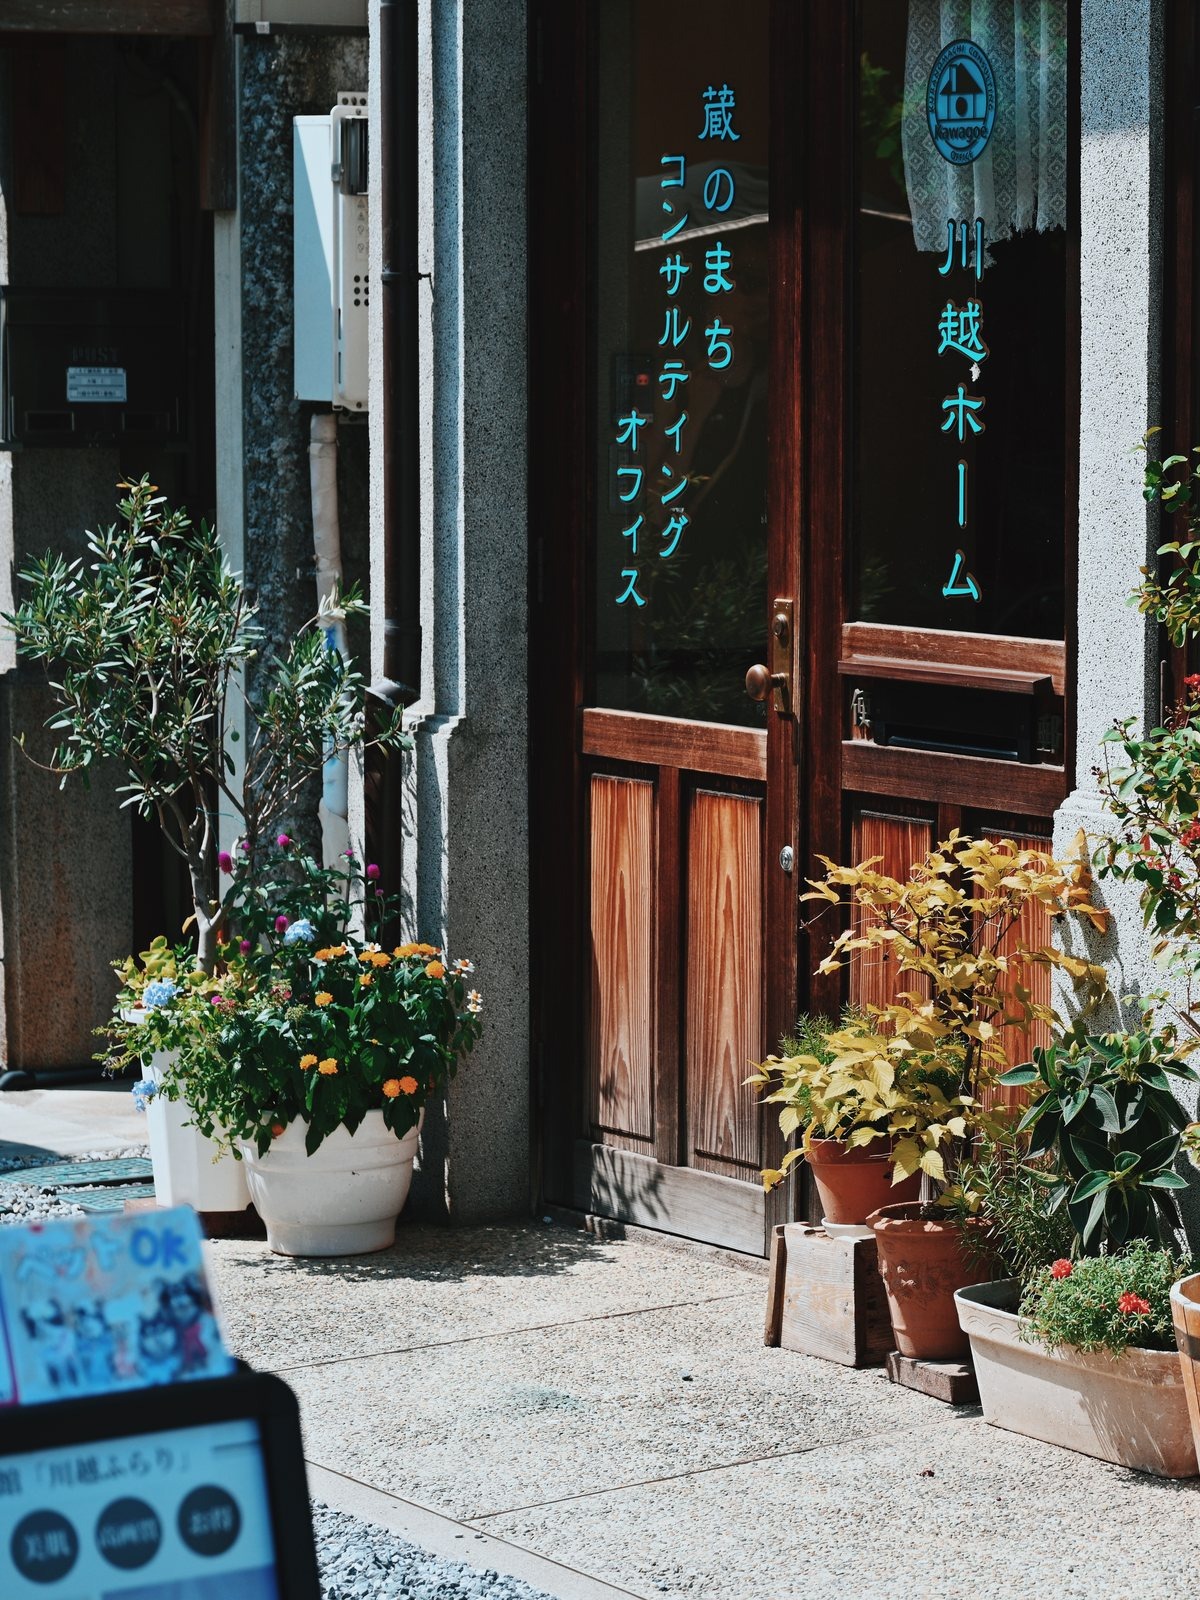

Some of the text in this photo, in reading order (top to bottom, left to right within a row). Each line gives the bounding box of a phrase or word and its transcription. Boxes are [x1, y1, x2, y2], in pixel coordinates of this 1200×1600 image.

[697, 83, 740, 370] 蔵のまち
[934, 124, 988, 143] Kawagoe
[658, 154, 690, 558] コンサルティング
[937, 218, 987, 602] 川越ホーム
[615, 410, 646, 606] オフィス
